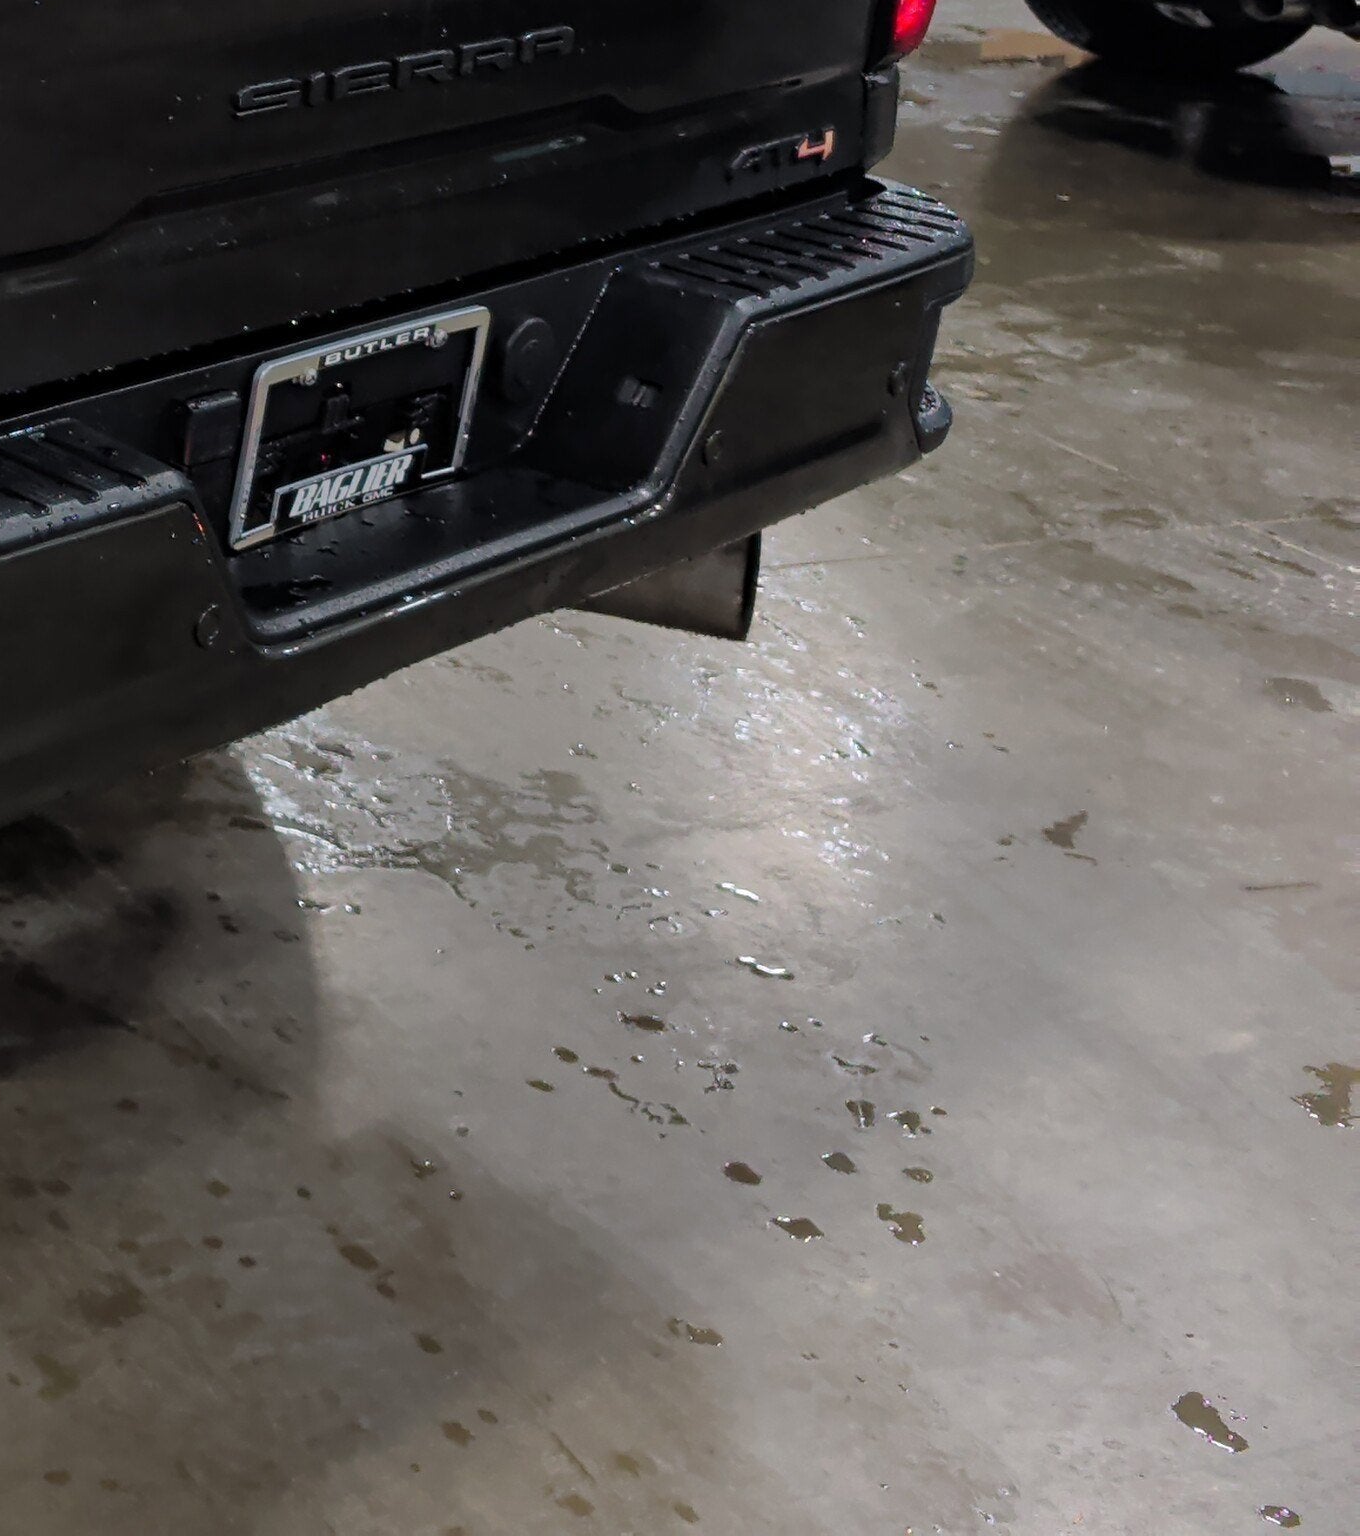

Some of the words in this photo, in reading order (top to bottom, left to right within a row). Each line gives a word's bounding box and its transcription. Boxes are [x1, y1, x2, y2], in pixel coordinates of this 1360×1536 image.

[234, 25, 575, 118] SIERRA
[324, 326, 431, 367] BUTLER
[288, 454, 414, 518] BAGLIER
[362, 486, 395, 504] GMC
